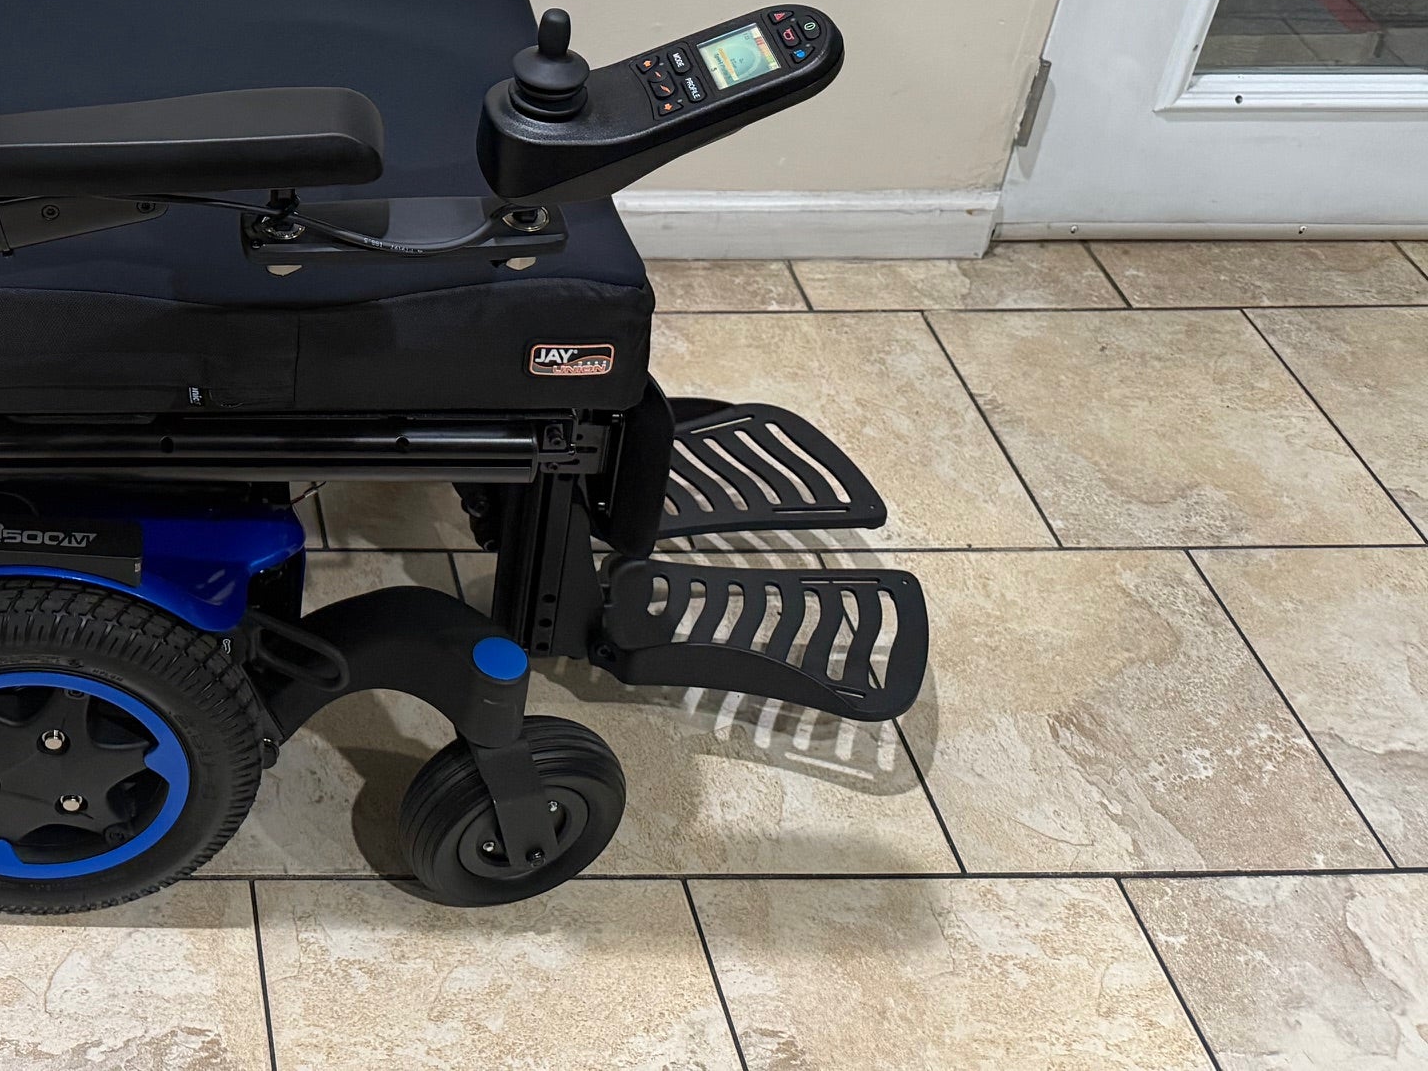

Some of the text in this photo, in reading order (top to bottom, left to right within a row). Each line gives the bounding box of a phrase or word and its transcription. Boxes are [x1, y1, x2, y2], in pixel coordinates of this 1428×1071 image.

[671, 53, 685, 68] MODE
[684, 77, 701, 99] PROFILE
[553, 361, 606, 373] UNION
